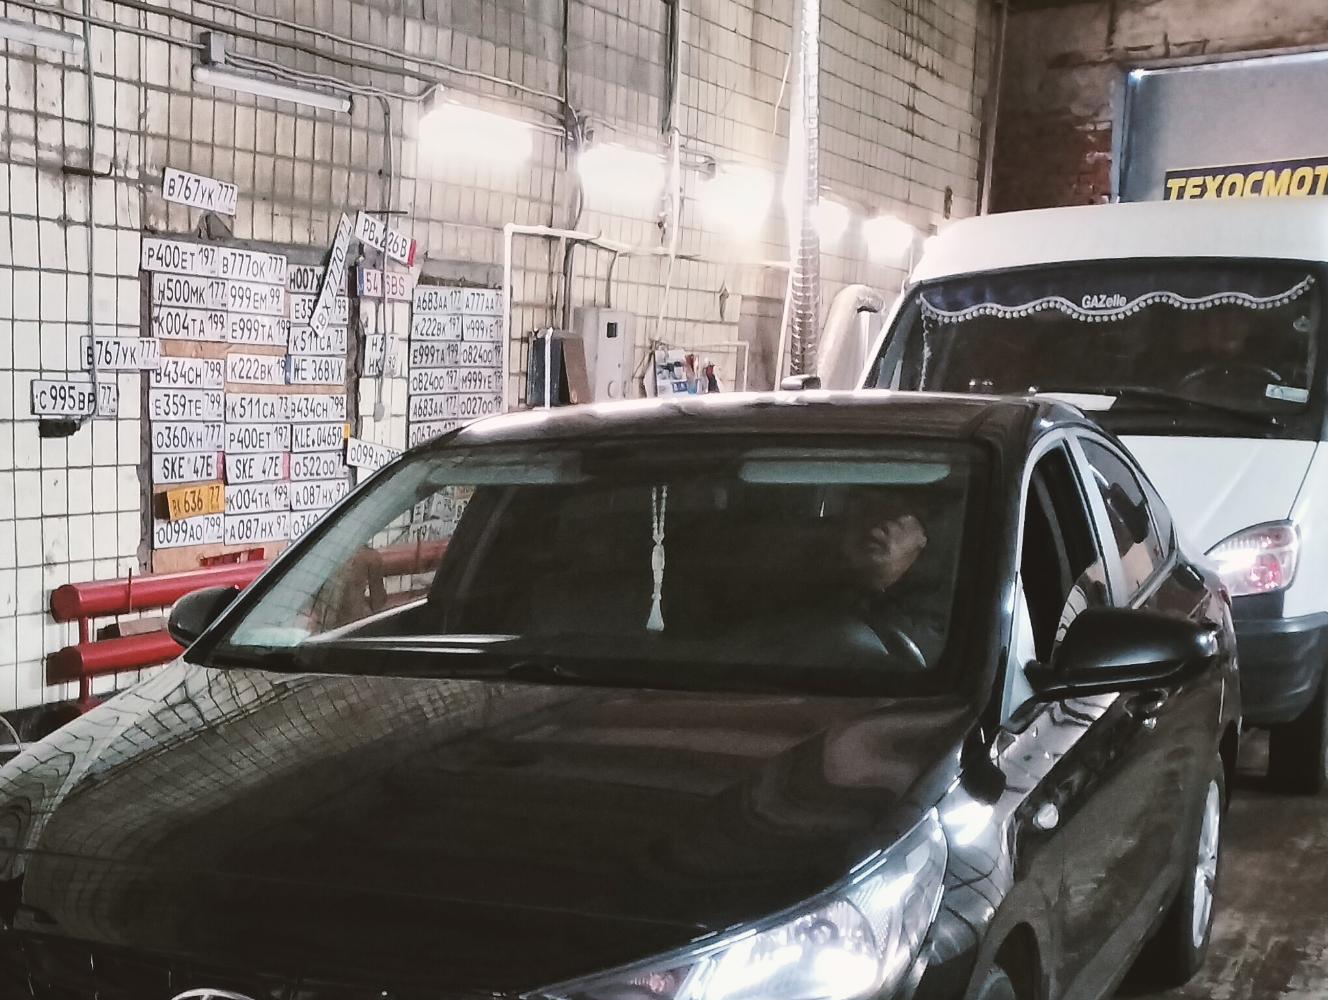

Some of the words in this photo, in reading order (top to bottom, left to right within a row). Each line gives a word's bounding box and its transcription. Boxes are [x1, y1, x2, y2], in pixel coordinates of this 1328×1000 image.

[168, 175, 215, 206] В767УК
[147, 244, 195, 271] Р400ЕТ
[222, 253, 265, 278] В777ОК
[158, 278, 206, 305] Н500МК
[158, 312, 205, 337] К004ТА
[231, 317, 273, 341] Е999ТА
[230, 358, 272, 381] К222ВК
[155, 394, 202, 416] Е359ТЕ
[229, 427, 271, 449] Р400ЕТ
